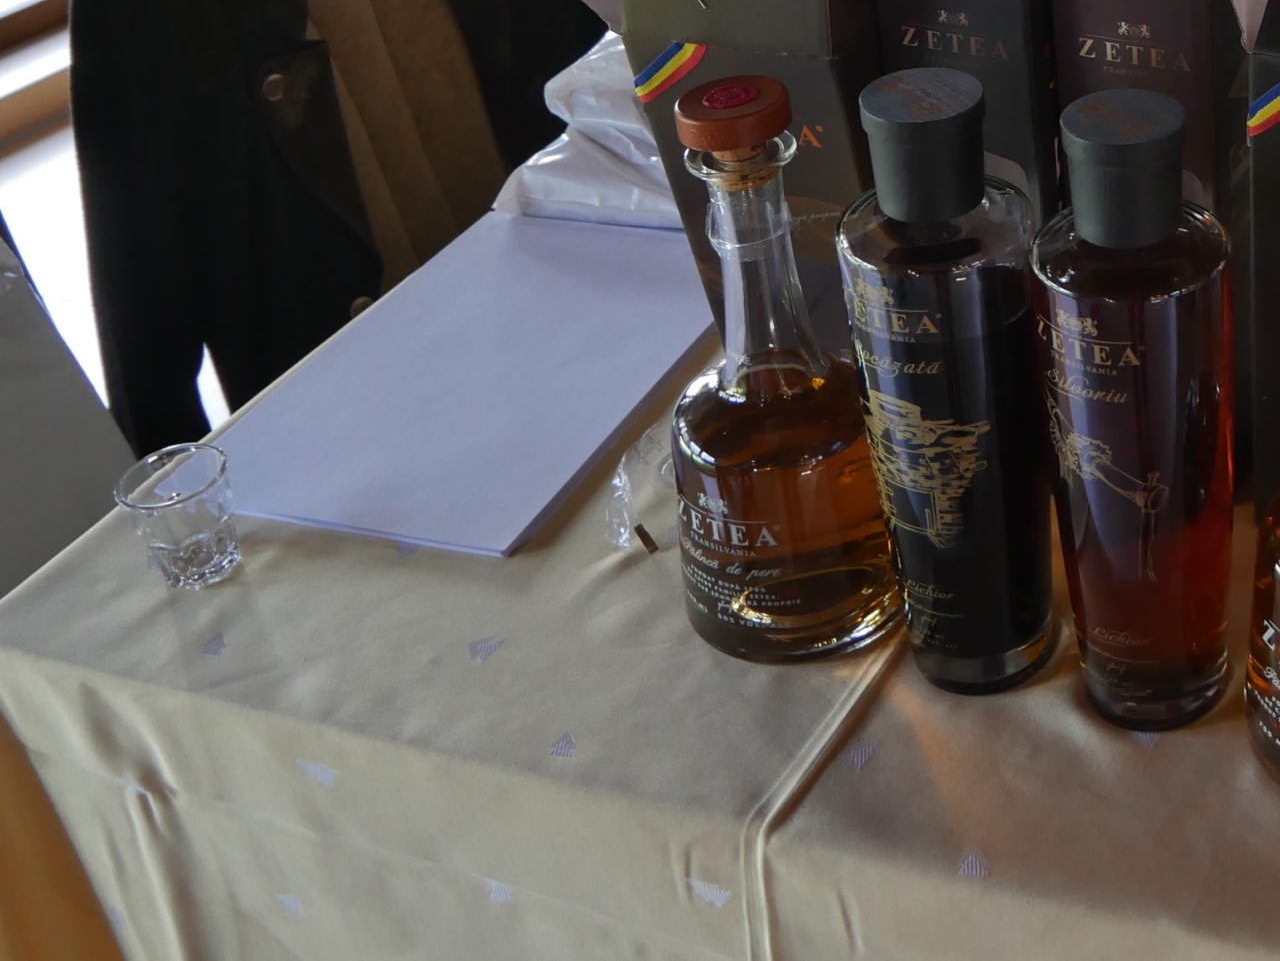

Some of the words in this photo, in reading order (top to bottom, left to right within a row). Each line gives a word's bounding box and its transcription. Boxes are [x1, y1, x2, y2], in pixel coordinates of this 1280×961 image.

[901, 25, 1009, 60] ZETEA
[1079, 37, 1190, 72] ZETEA
[1036, 315, 1141, 367] ZETEA
[679, 498, 779, 547] ZETEA
[690, 531, 758, 557] TRANSILVANIA
[745, 567, 781, 582] pere
